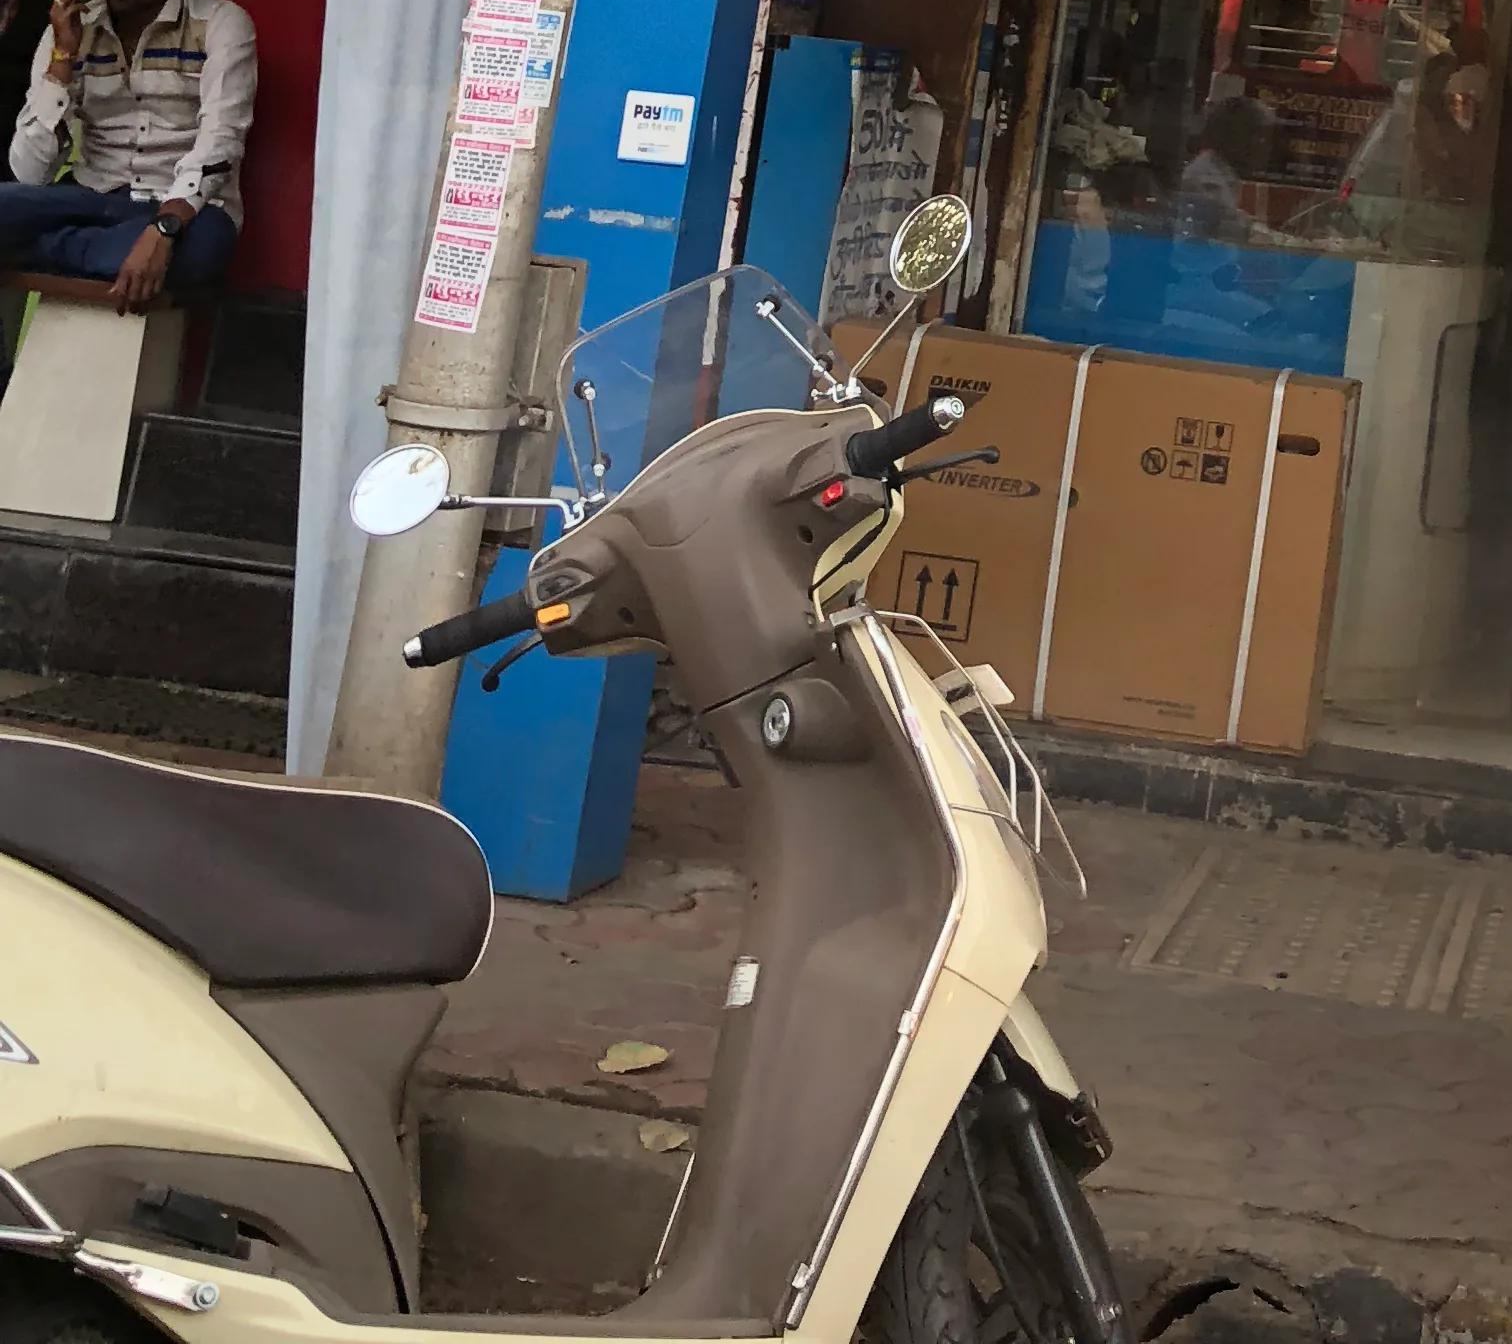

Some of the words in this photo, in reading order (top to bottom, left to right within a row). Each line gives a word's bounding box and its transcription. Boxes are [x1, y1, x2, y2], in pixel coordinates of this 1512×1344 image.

[633, 103, 684, 123] Paytm
[929, 374, 992, 394] DAIKIN
[938, 468, 1024, 498] INVERTER
